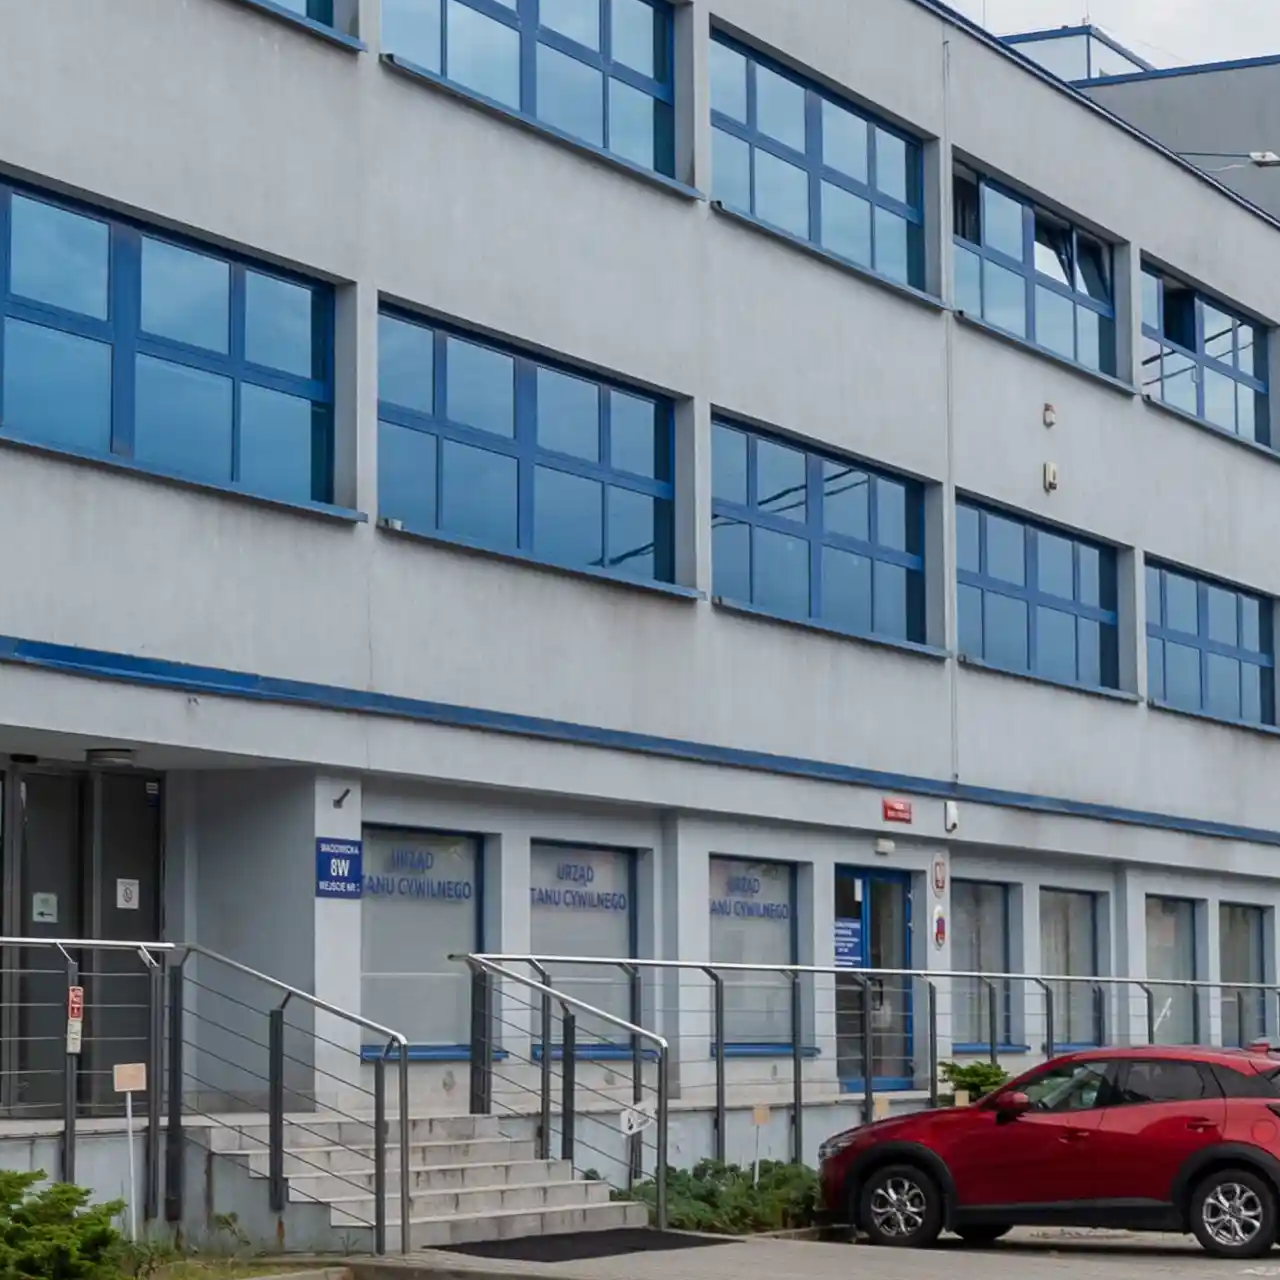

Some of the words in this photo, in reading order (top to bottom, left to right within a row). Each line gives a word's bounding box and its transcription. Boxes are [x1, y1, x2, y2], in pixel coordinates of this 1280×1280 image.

[330, 858, 350, 877] 8W
[556, 862, 595, 887] URZĄD
[398, 877, 472, 900] CYWILNEGO
[563, 889, 627, 910] CYWILNEGO
